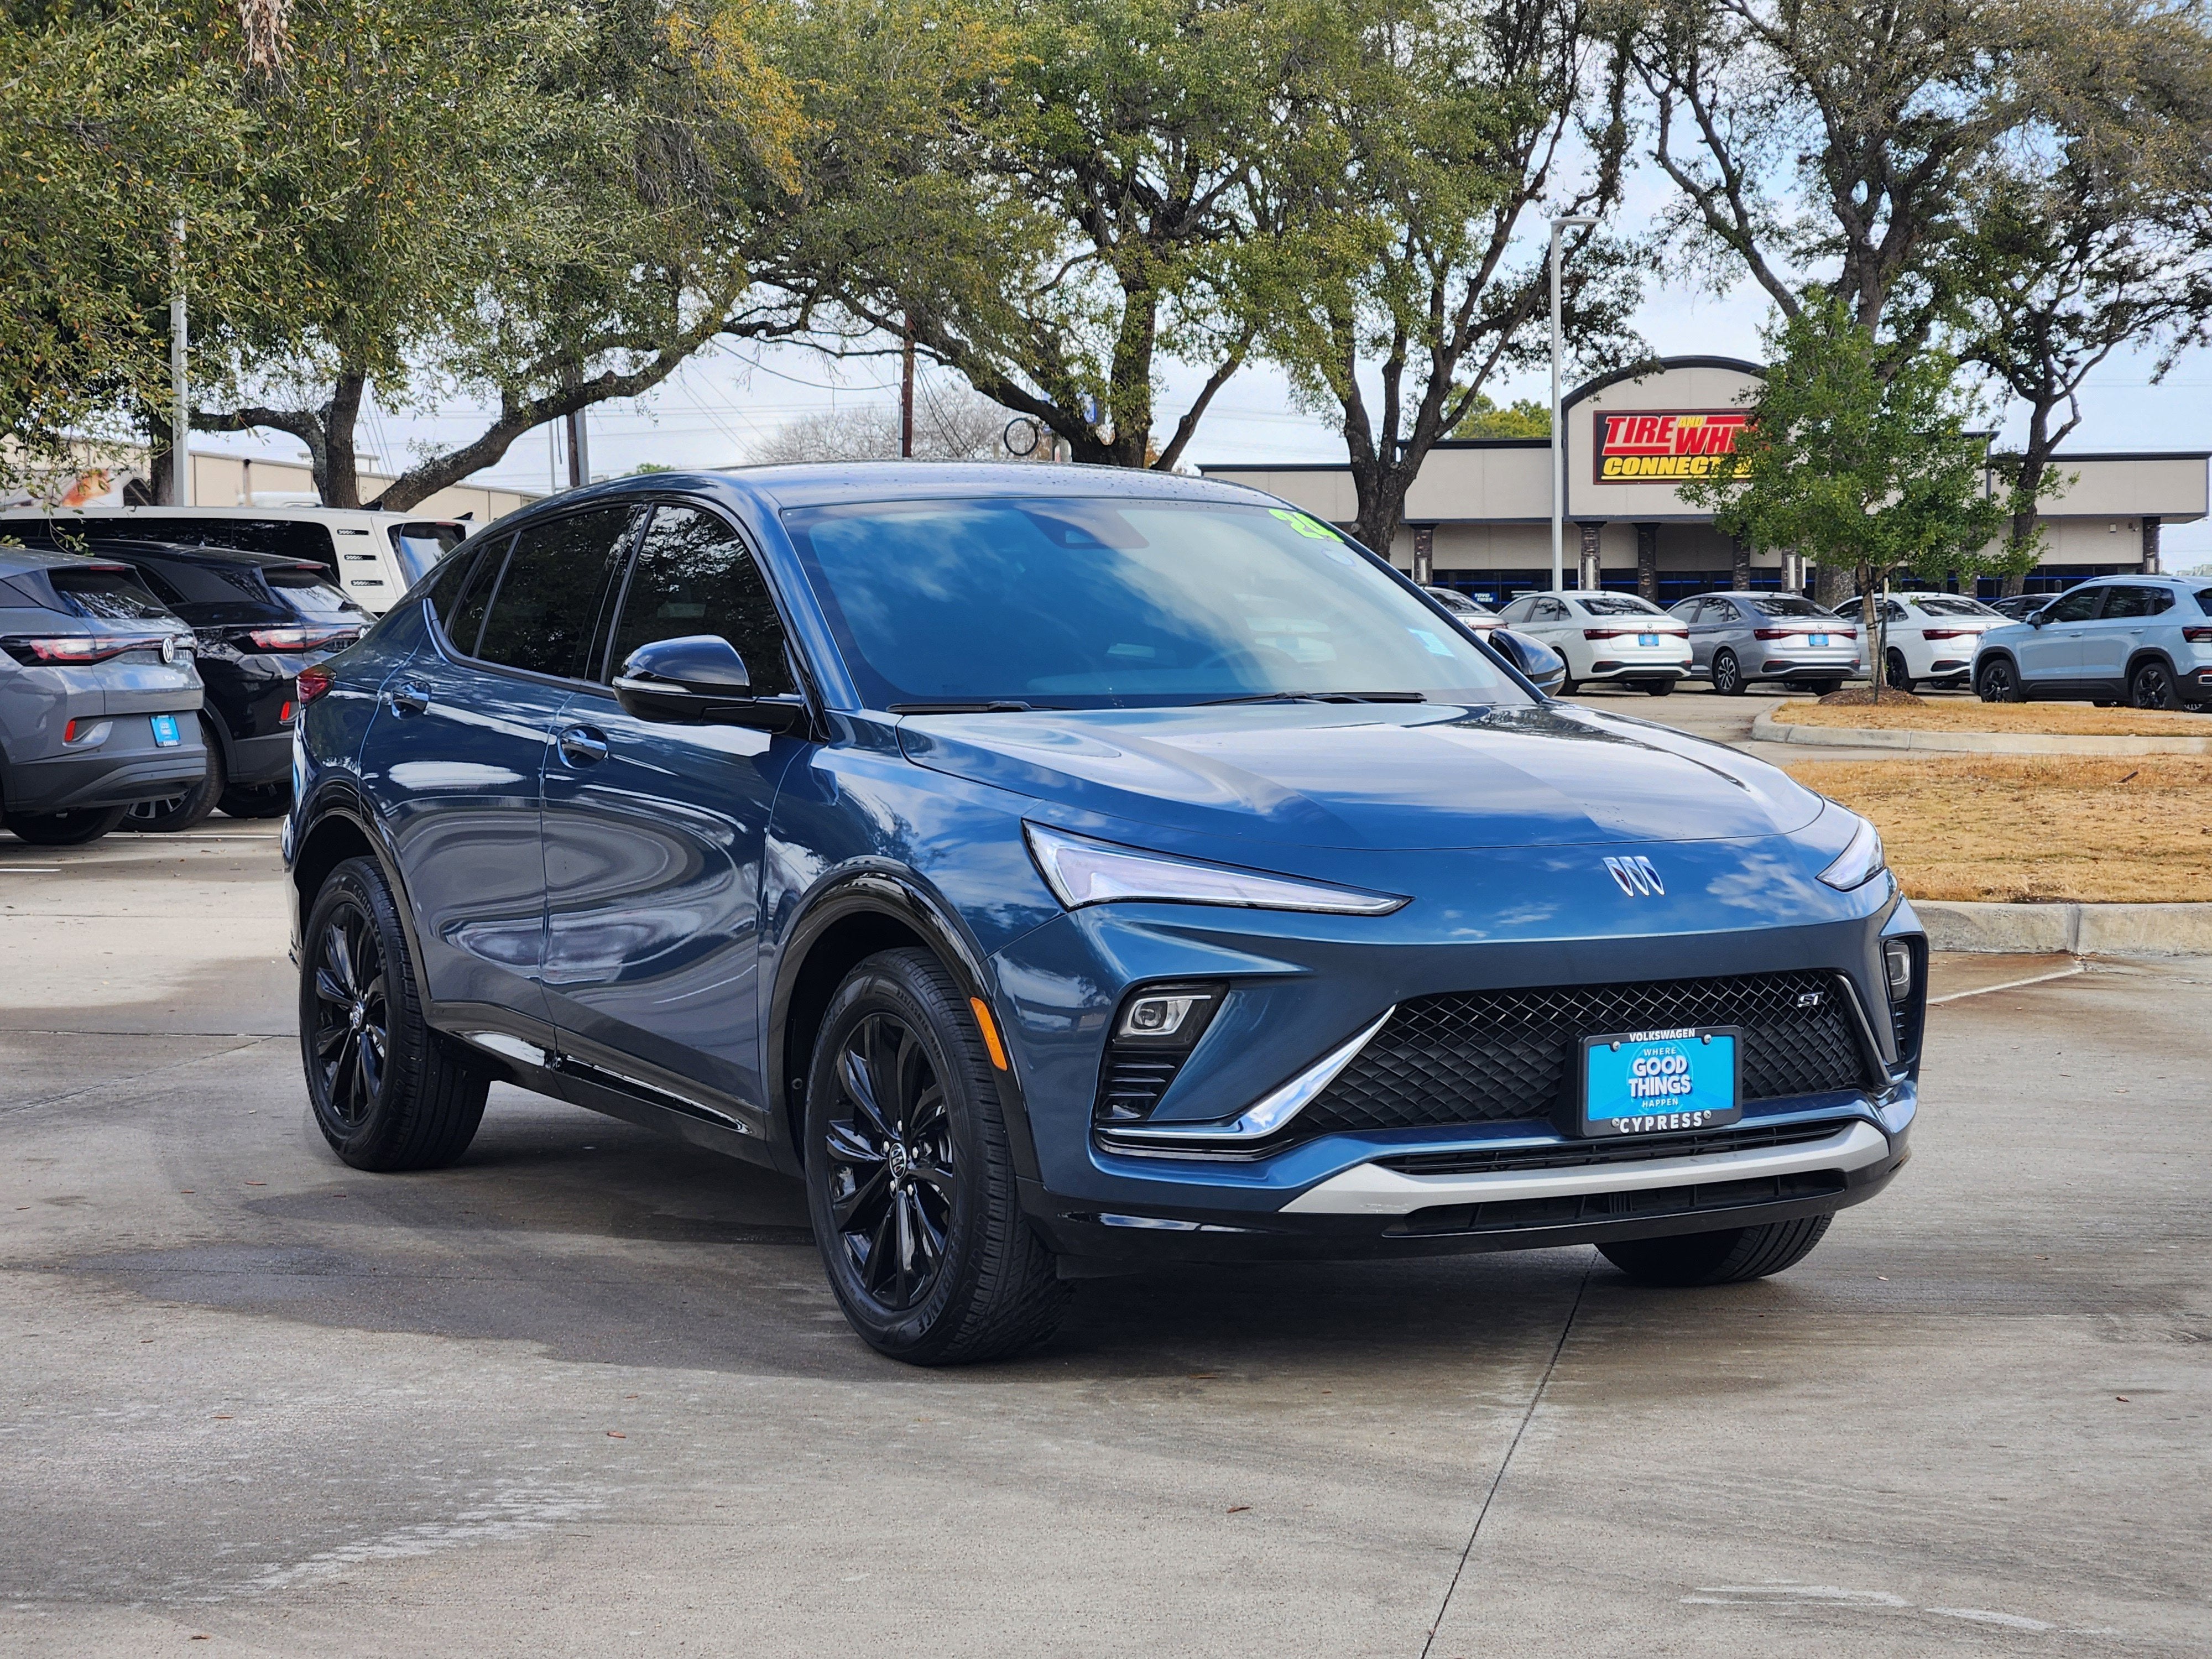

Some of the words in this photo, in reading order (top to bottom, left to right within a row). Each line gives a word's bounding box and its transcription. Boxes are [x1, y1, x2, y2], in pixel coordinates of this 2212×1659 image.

[1606, 416, 1676, 444] TIRE
[1678, 416, 1704, 427] AND
[1604, 456, 1760, 475] CONNECT
[1268, 509, 1344, 542] 24
[1797, 992, 1824, 1008] ST
[1629, 1028, 1695, 1043] VOLKSWAGEN
[1644, 1047, 1677, 1056] WHERE
[1633, 1055, 1687, 1077] GOOD
[1628, 1074, 1691, 1097] THINGS
[1641, 1098, 1678, 1108] HAPPEN
[1619, 1112, 1702, 1134] CYPRESS
